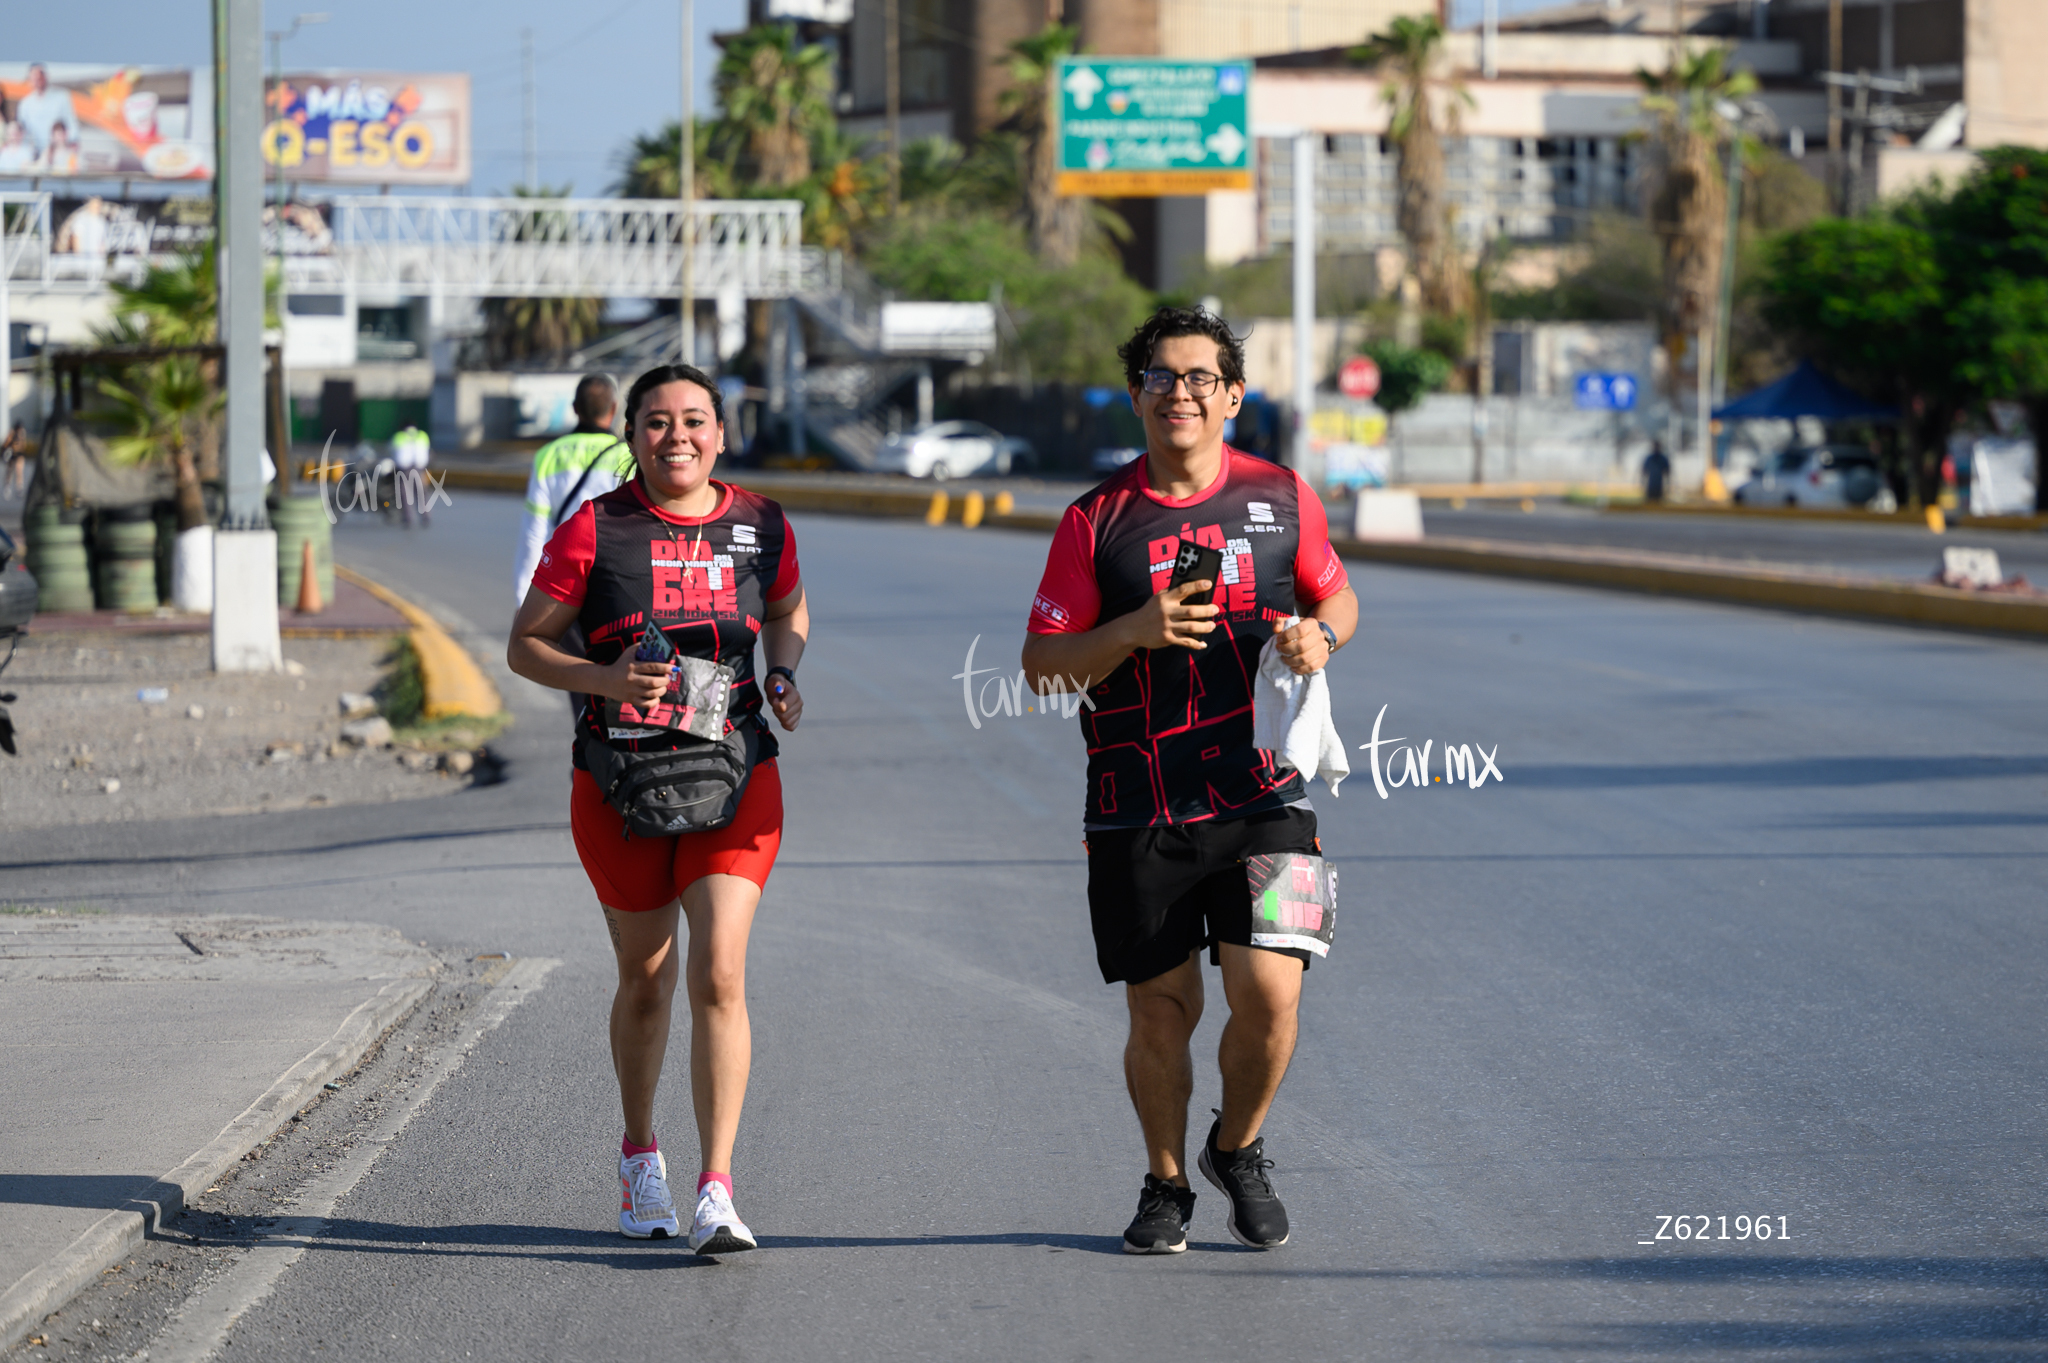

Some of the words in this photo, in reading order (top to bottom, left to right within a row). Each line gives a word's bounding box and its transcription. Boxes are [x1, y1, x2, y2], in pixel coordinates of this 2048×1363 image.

[305, 77, 391, 121] MÁS
[261, 118, 434, 169] Q-ESO
[1243, 524, 1285, 534] SEAT
[1227, 538, 1251, 548] DEL
[726, 545, 763, 554] SEAT
[651, 559, 683, 568] MEDIA
[684, 560, 734, 568] MARATON
